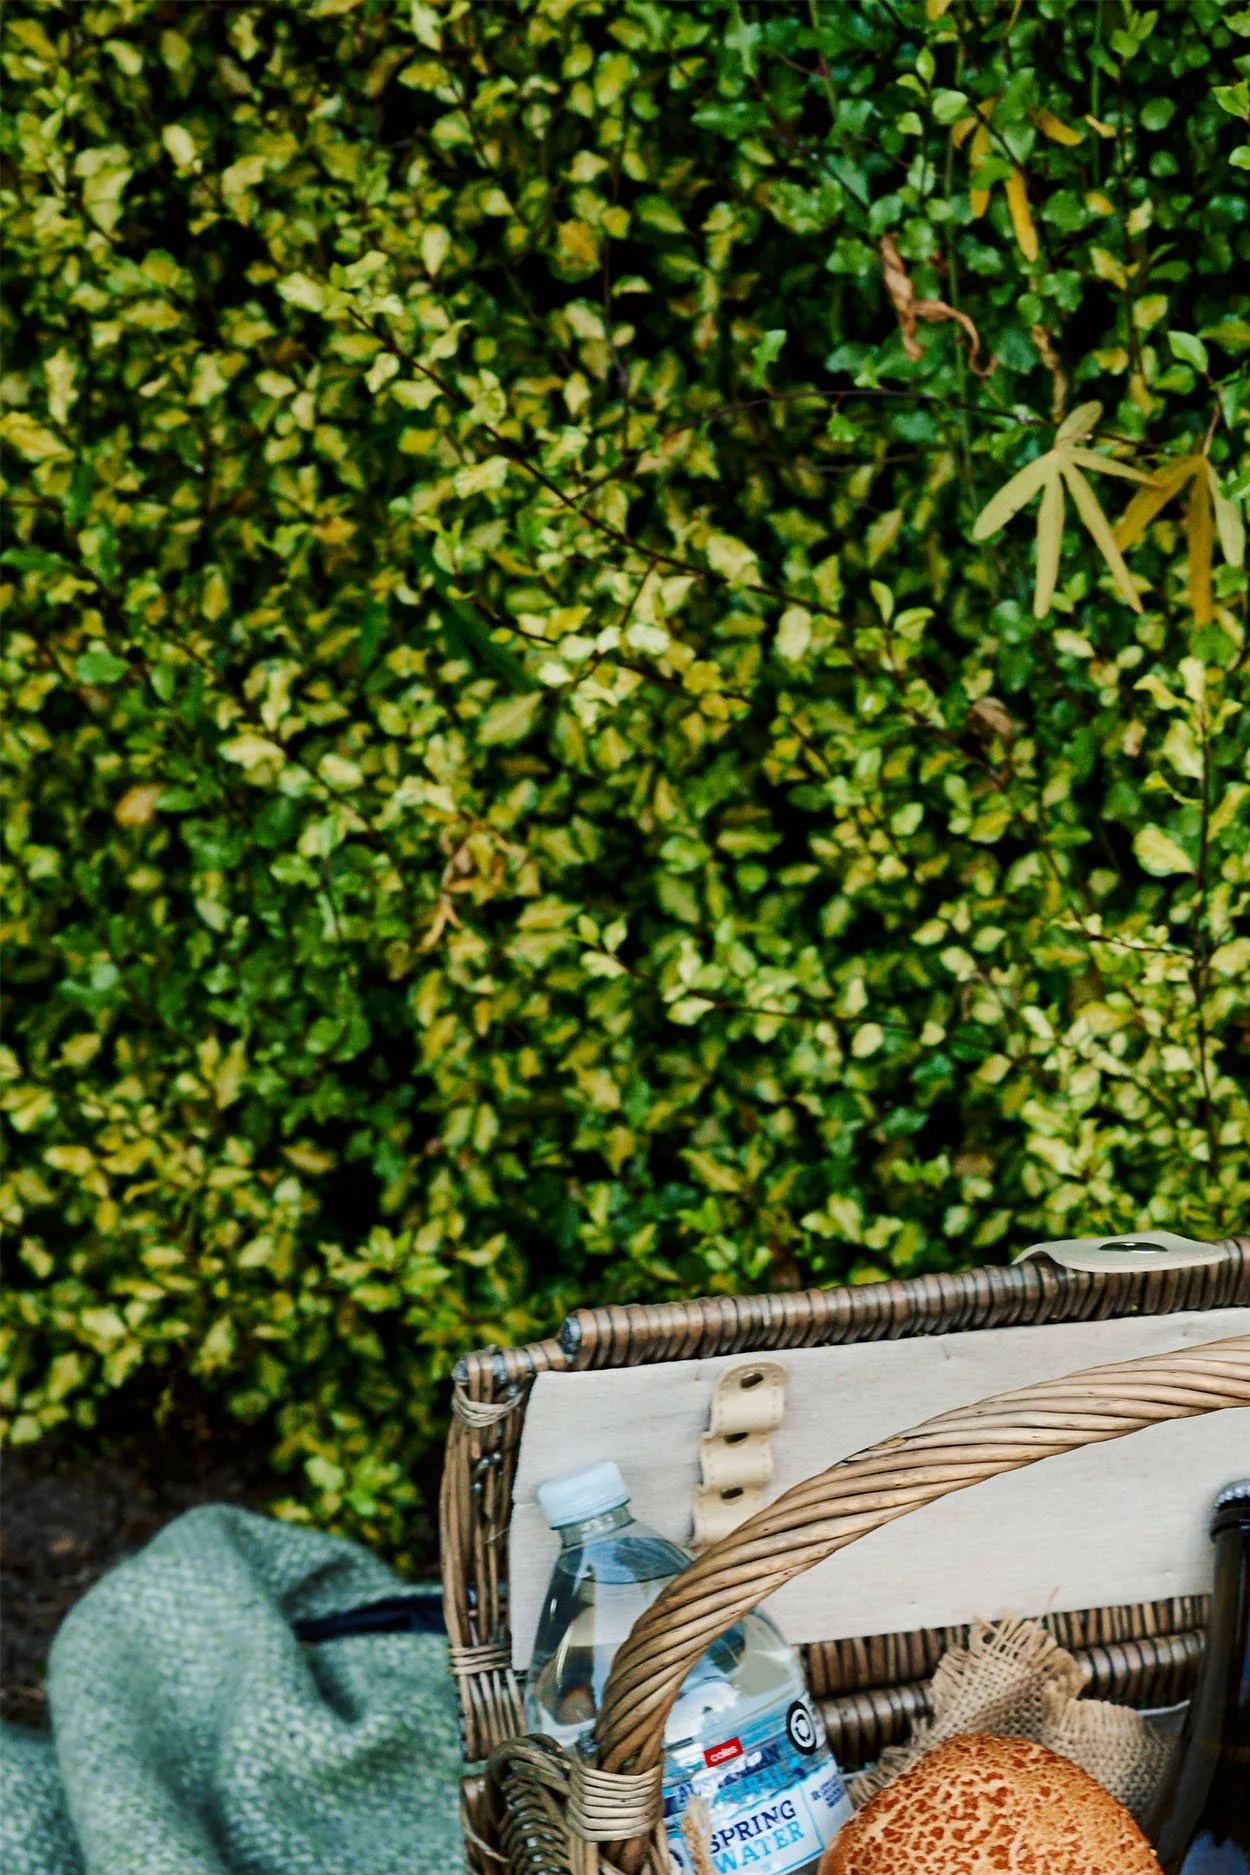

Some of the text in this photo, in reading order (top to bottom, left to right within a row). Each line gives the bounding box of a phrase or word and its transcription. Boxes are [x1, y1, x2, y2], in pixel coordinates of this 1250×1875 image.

[710, 1745, 739, 1763] coles
[711, 1799, 796, 1854] SPRING
[712, 1820, 805, 1875] WATER
